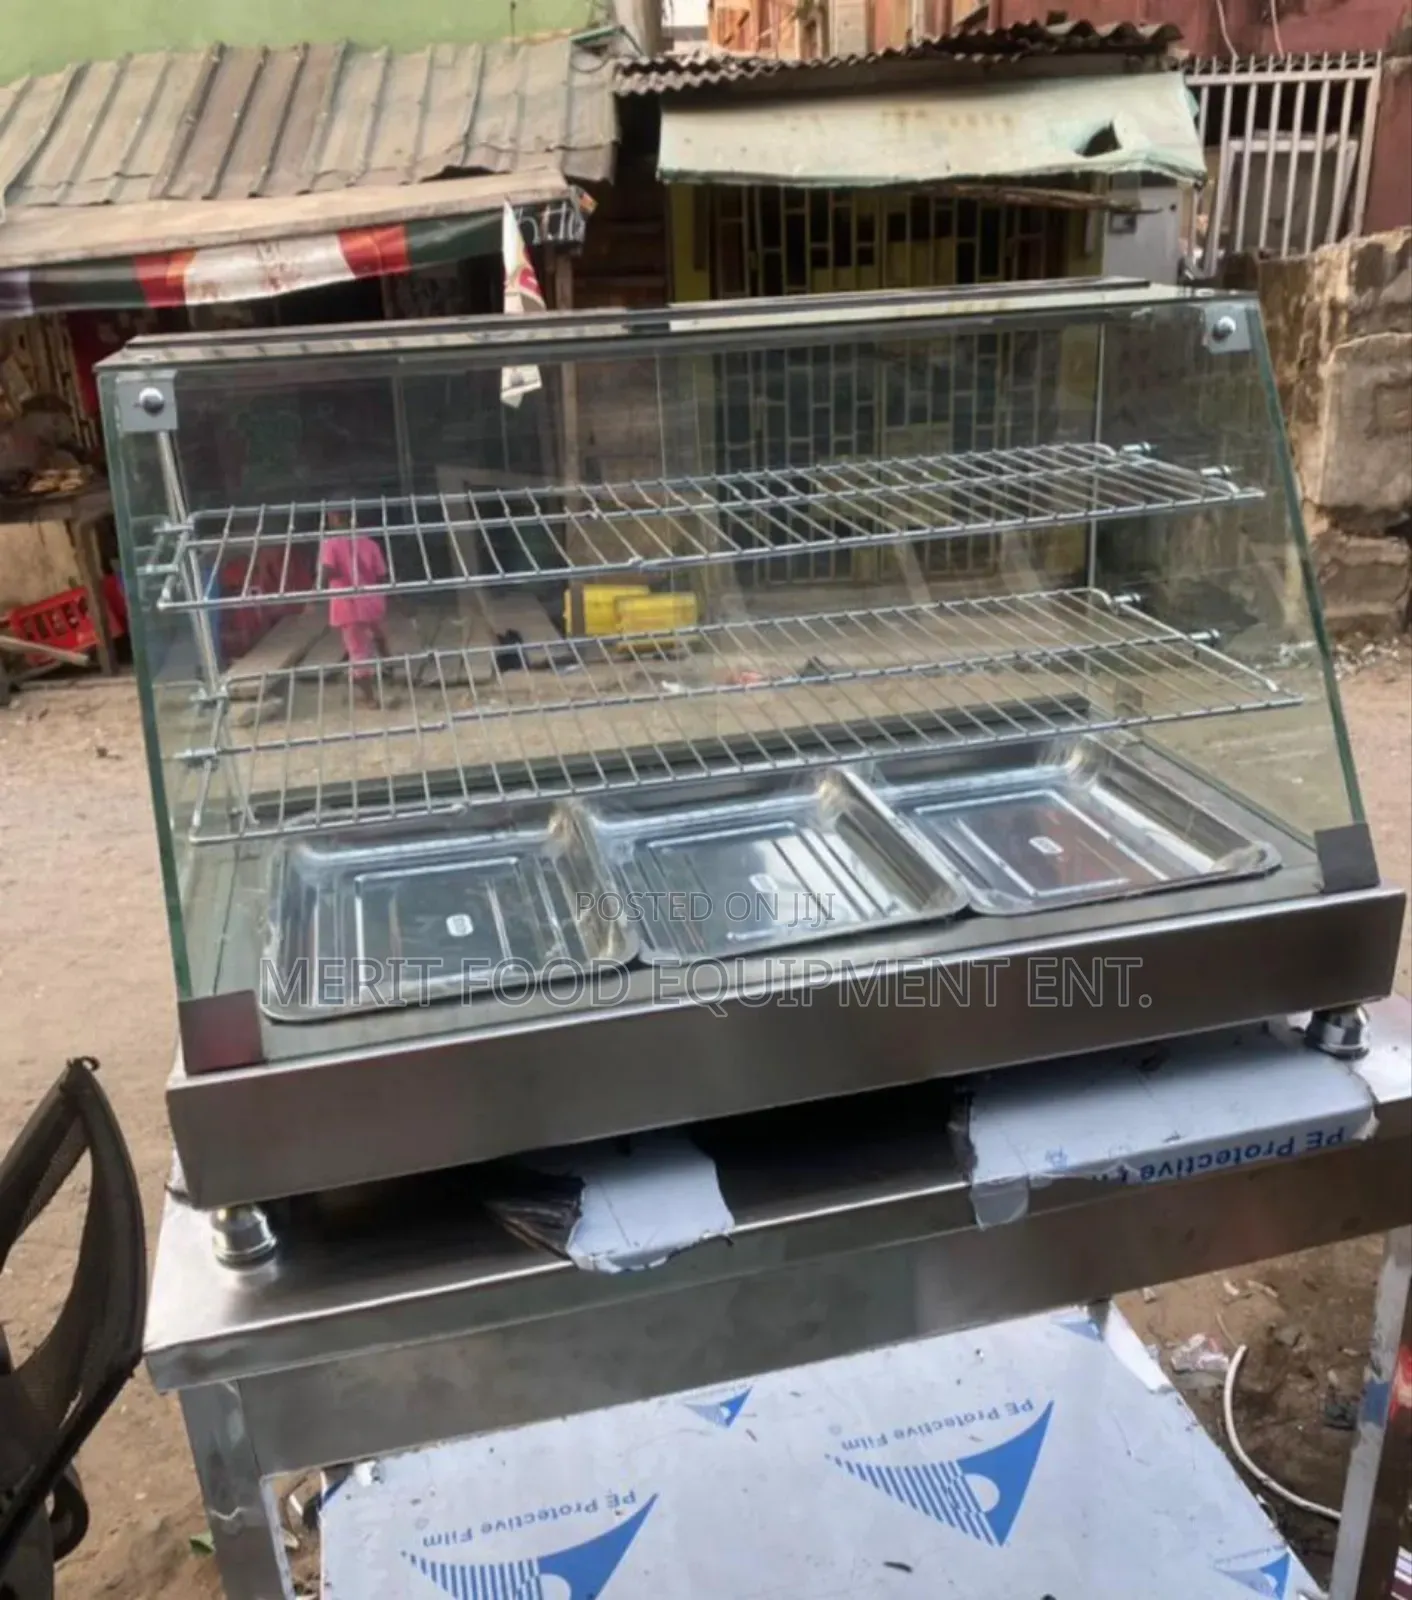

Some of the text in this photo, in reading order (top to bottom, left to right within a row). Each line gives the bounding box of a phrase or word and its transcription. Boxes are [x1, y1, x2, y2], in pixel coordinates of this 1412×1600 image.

[1140, 1137, 1295, 1183] Protective
[1305, 1126, 1346, 1150] PE
[841, 1399, 1034, 1452] PE Protective Film
[422, 1489, 638, 1548] PE Protective Film
